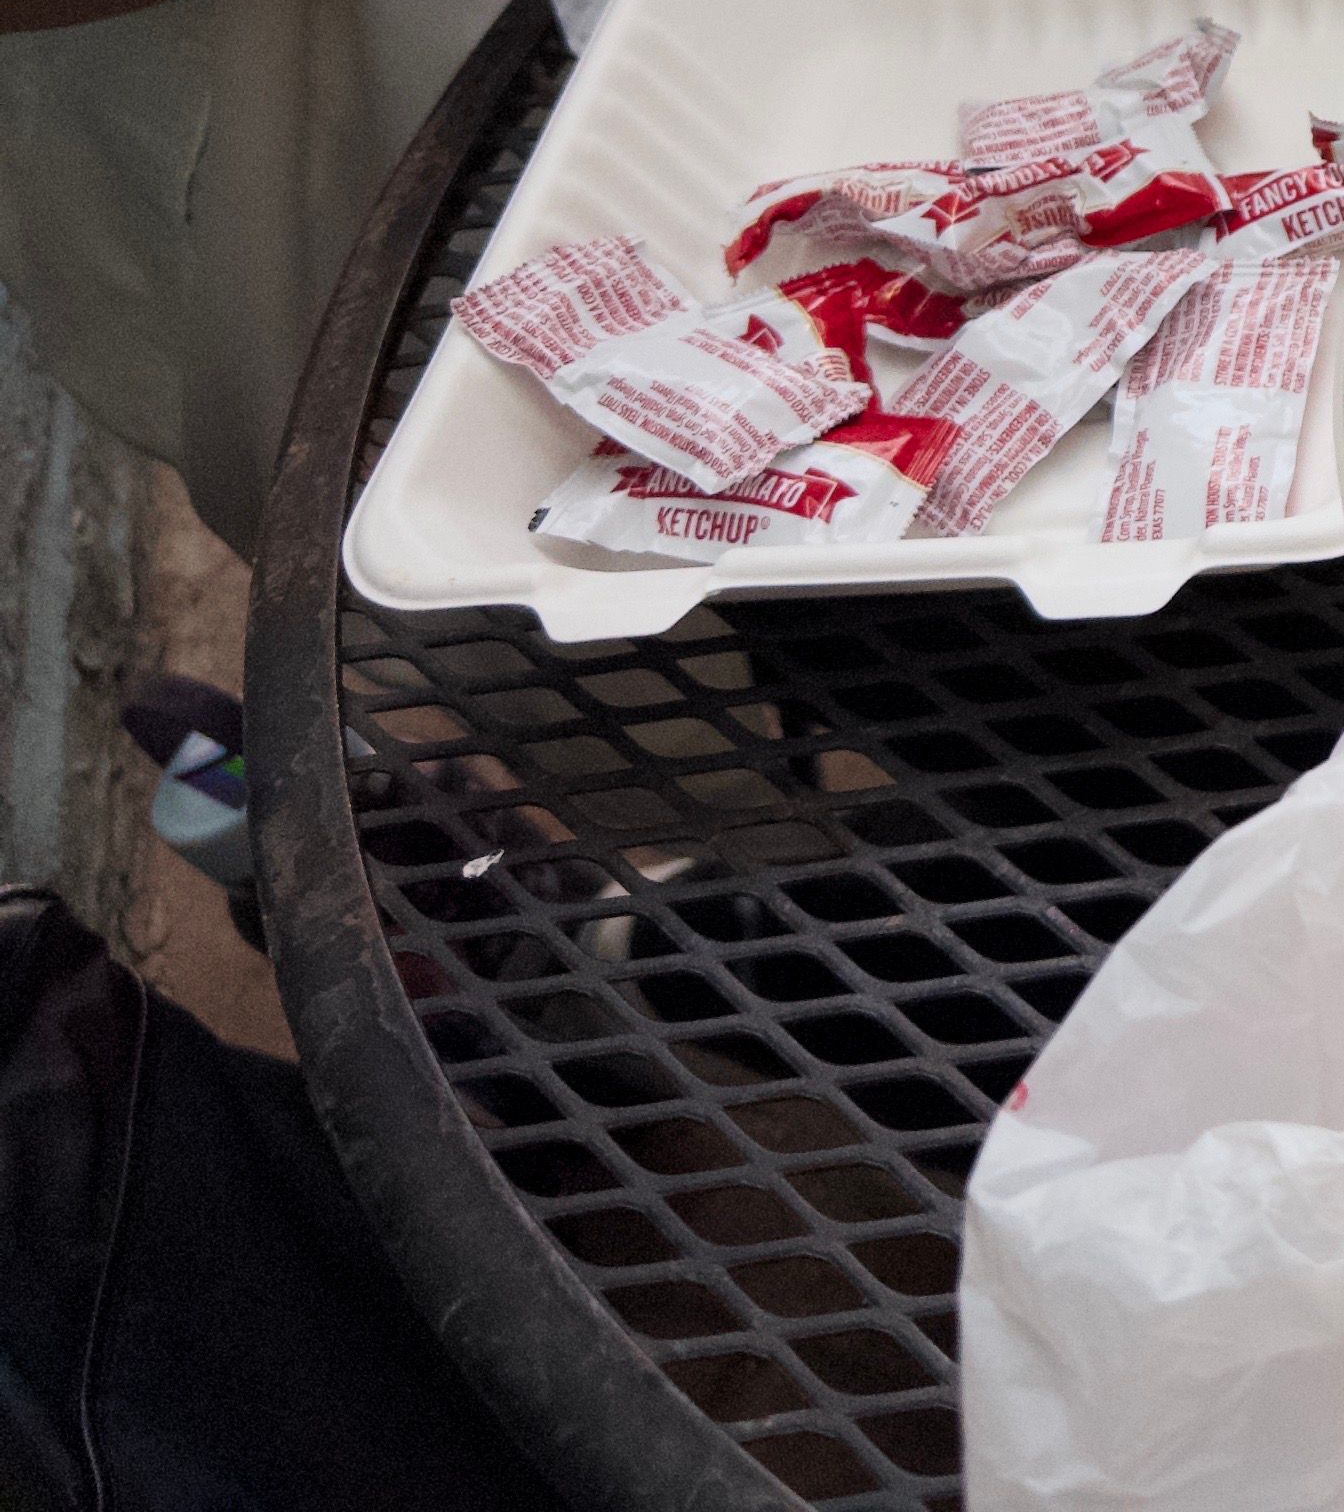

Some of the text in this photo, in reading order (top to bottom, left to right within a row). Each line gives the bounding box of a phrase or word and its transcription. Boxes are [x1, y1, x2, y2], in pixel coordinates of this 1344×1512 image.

[1239, 174, 1308, 220] FANCY
[961, 366, 991, 399] STORE
[953, 393, 970, 409] IN
[984, 396, 1040, 460] INGREDIENTS:
[1035, 418, 1065, 449] STORE
[1027, 443, 1043, 459] IN
[726, 467, 807, 511] OMATO
[1116, 520, 1132, 542] Corn
[1149, 488, 1168, 541] EXAS 77077
